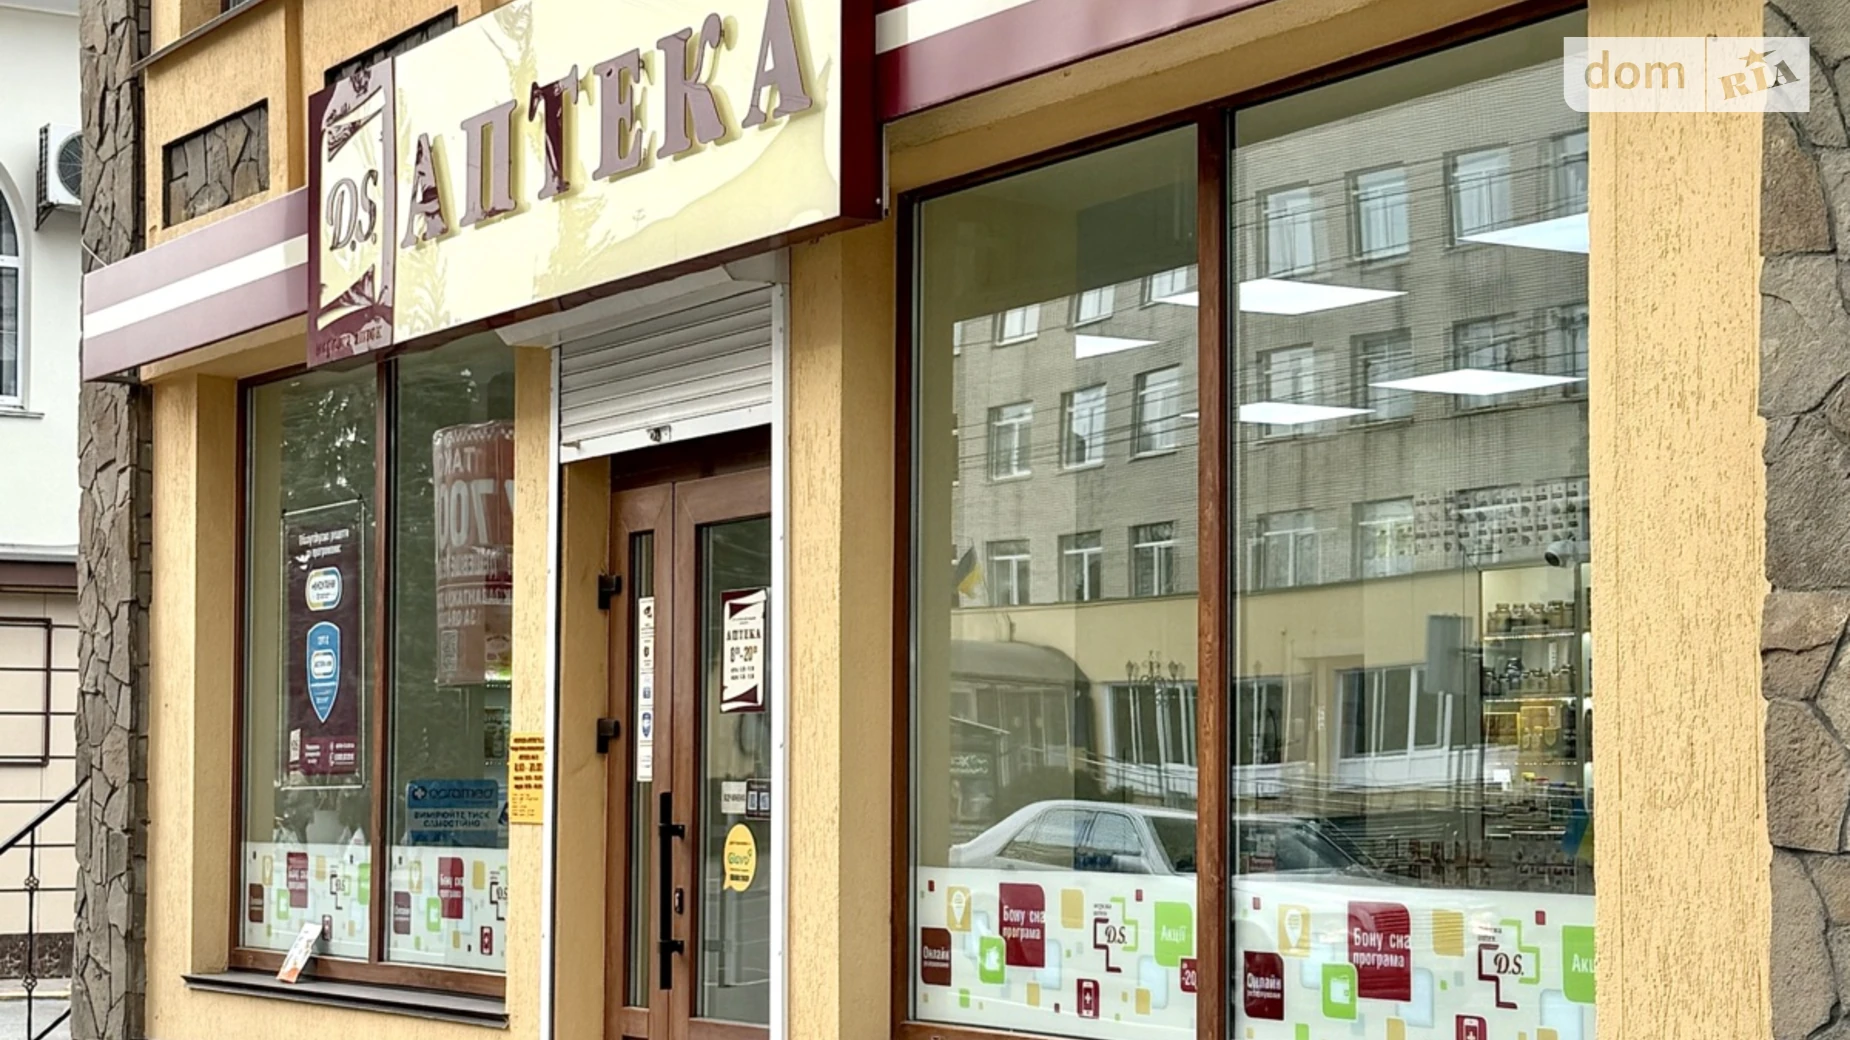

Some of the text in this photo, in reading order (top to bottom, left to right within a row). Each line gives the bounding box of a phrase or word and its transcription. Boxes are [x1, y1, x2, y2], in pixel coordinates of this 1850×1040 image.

[401, 0, 813, 248] АПТЕКА
[726, 627, 761, 642] АПТЕКА
[468, 810, 491, 820] ТИСК
[1003, 905, 1025, 927] Бону
[1003, 925, 1041, 941] програма
[1160, 924, 1187, 942] Акції
[1353, 928, 1383, 952] Бону
[1353, 952, 1405, 970] програма
[1494, 952, 1525, 976] D.S.
[1246, 972, 1282, 990] Онлайн
